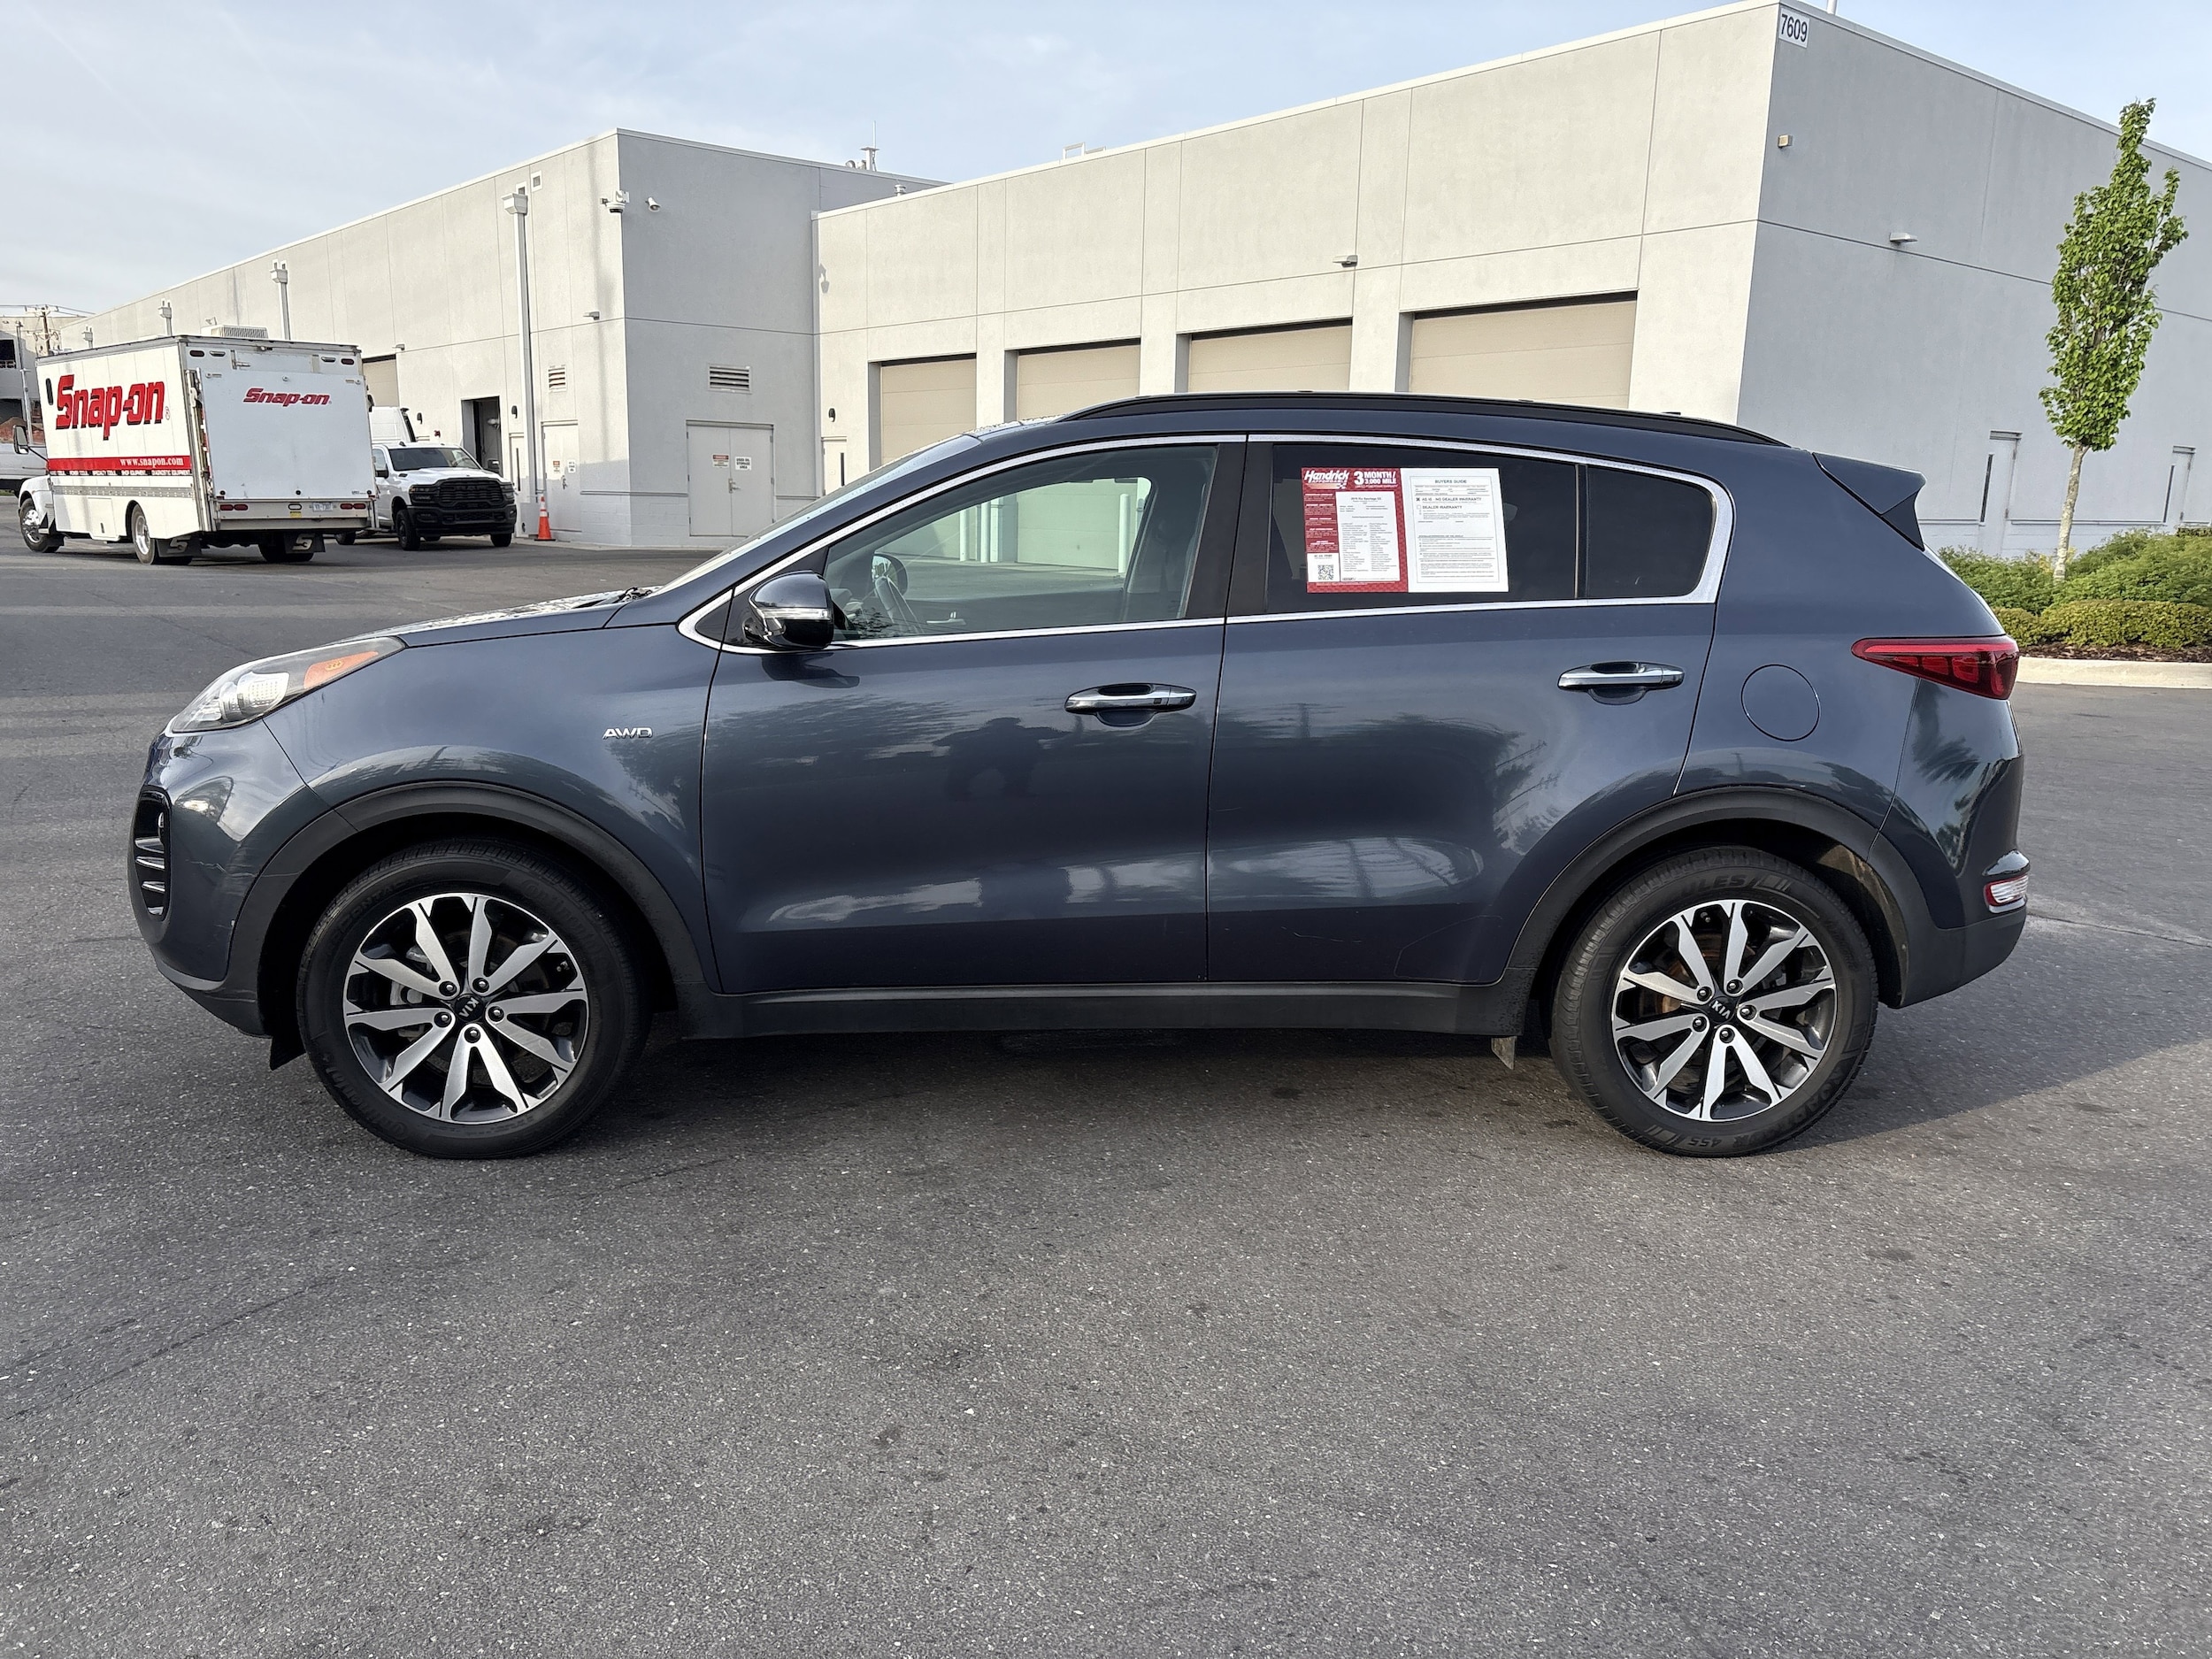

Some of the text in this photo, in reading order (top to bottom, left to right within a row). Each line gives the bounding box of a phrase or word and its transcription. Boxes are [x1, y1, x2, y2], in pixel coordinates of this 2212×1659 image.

[1781, 13, 1808, 42] 7609
[242, 388, 330, 407] Snap-on
[56, 374, 165, 441] Snap-on
[119, 457, 184, 468] www.snapon.com
[1304, 470, 1349, 483] Hendrick
[1354, 471, 1364, 485] 3
[602, 727, 653, 740] AWD
[458, 997, 480, 1018] KIA
[1711, 1000, 1732, 1019] KIA
